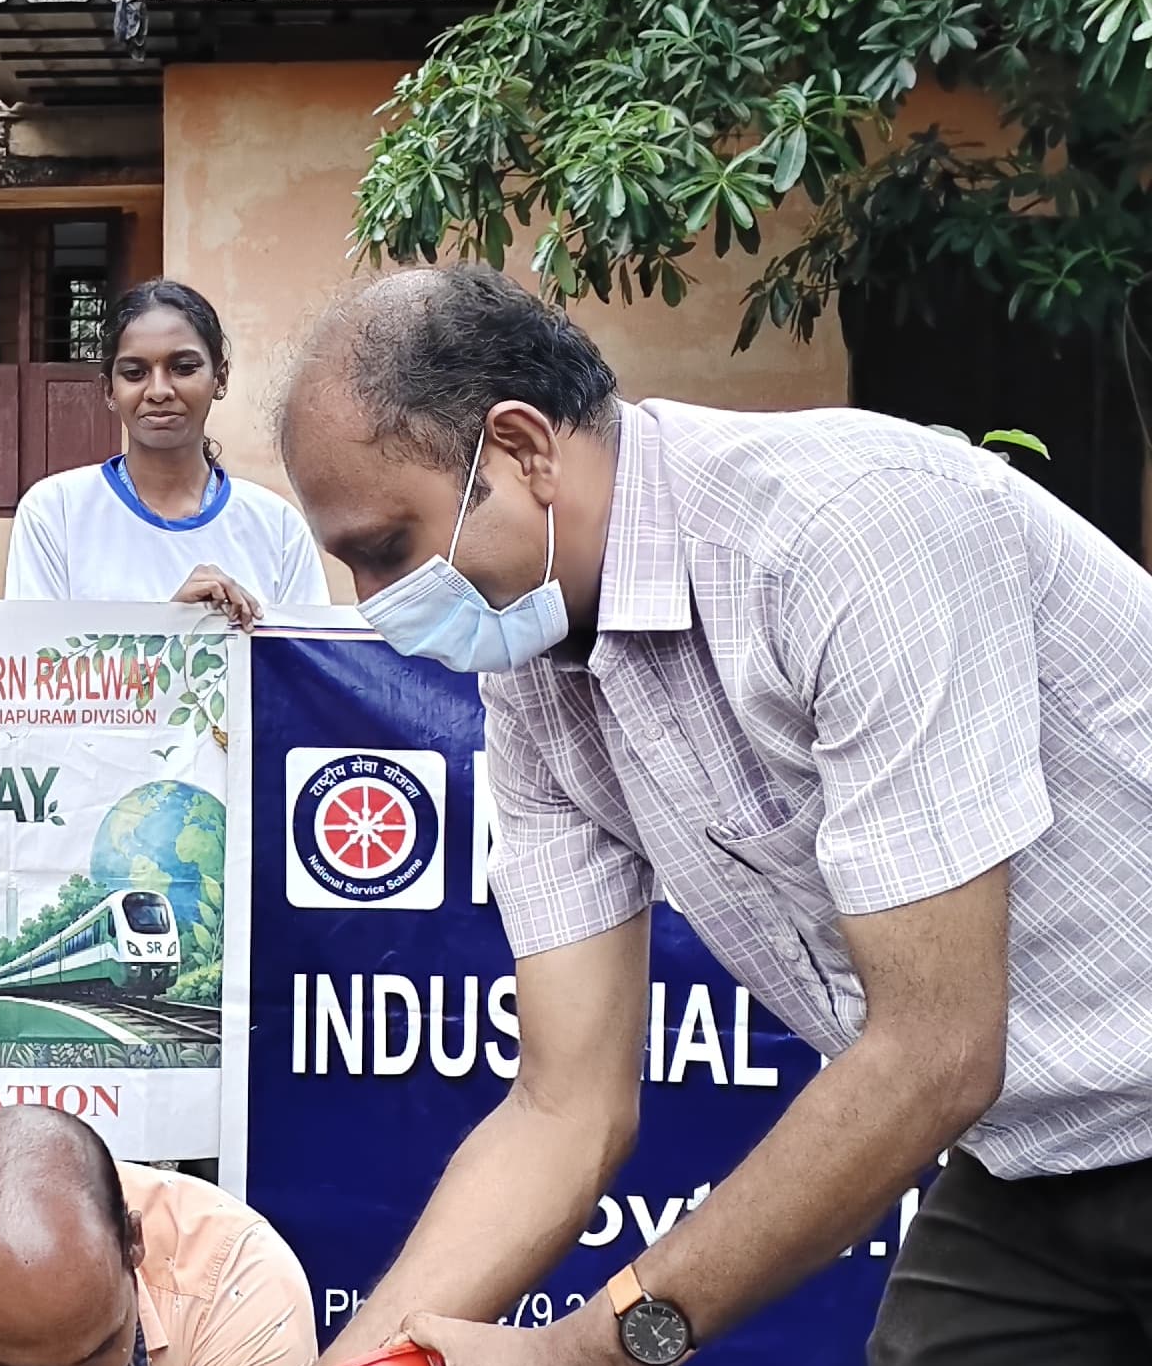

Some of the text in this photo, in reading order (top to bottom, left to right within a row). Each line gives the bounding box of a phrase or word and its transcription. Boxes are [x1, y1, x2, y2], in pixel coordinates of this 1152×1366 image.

[36, 656, 161, 700] RAILWAY
[81, 708, 157, 724] DIVISION
[308, 755, 422, 799] राष्ट्रीय सेवा योजना
[307, 853, 424, 896] National Service Scheme
[146, 941, 163, 954] SR
[292, 973, 778, 1086] INDUSIAL
